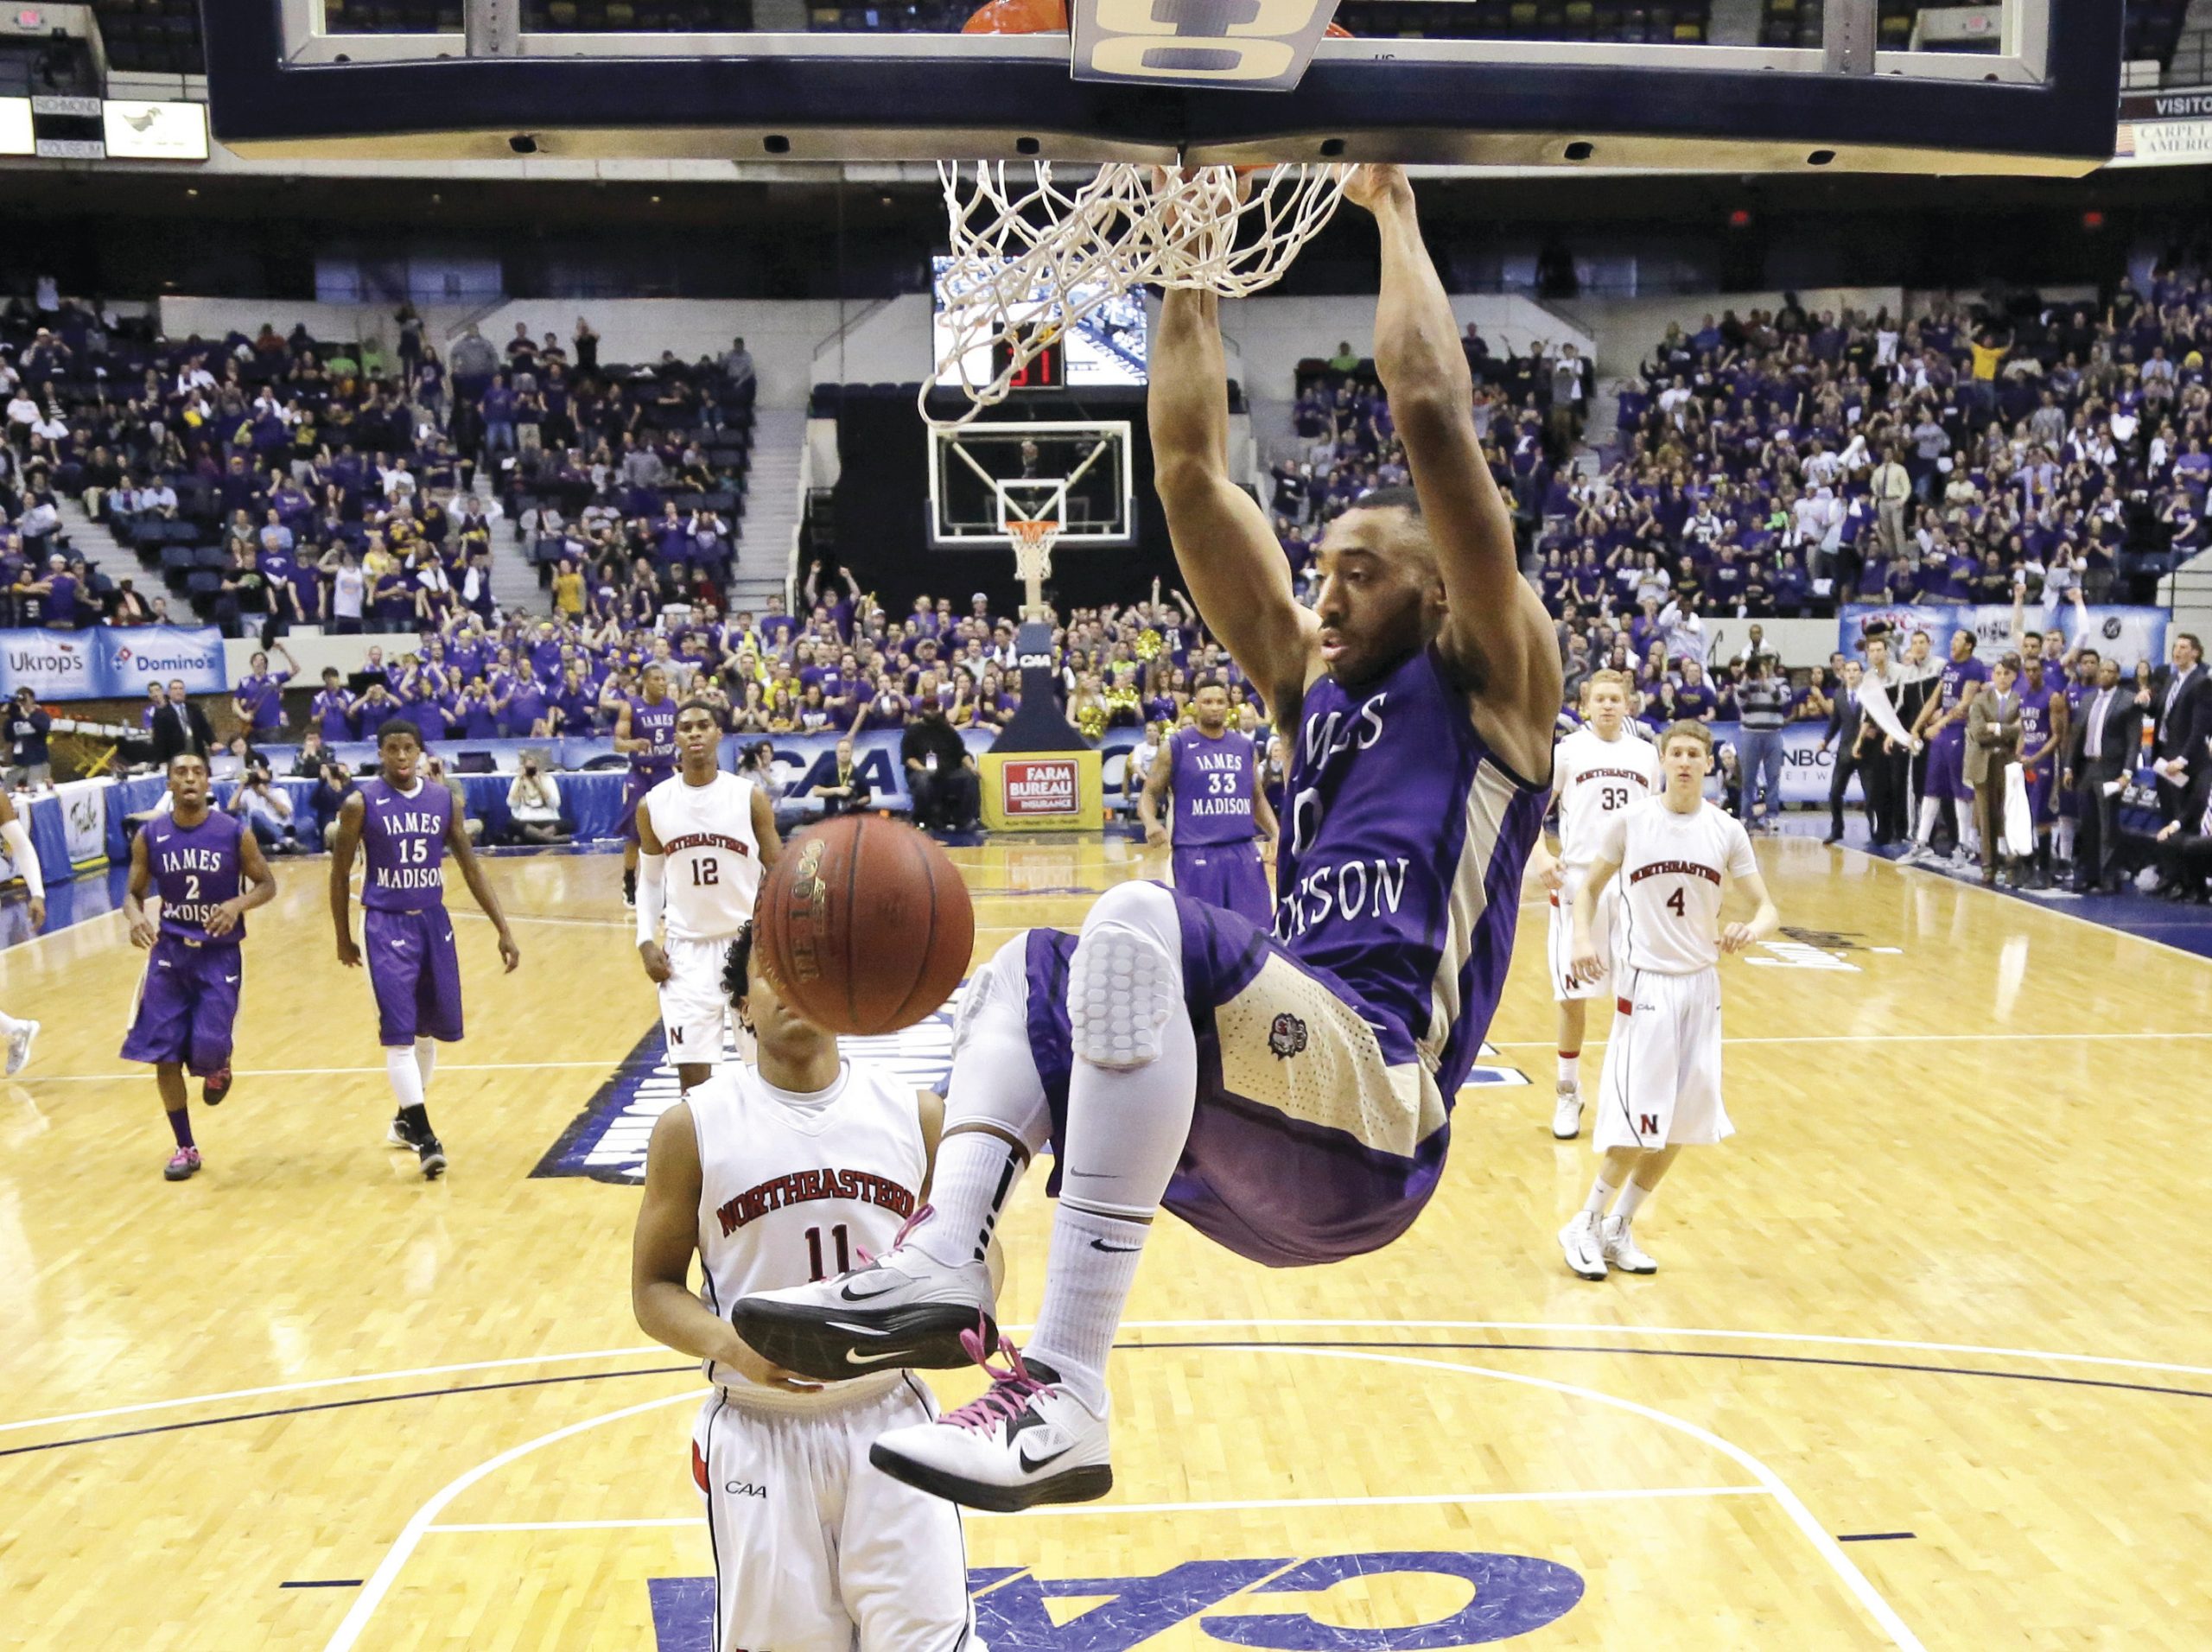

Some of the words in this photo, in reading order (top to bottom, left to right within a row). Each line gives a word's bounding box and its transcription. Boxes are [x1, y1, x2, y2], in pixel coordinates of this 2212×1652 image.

[137, 653, 215, 671] Domino's
[1020, 654, 1051, 667] CAA
[655, 728, 664, 743] 5
[1196, 753, 1242, 771] JAMES
[1027, 766, 1071, 781] FARM
[1208, 773, 1236, 793] 33
[1009, 780, 1072, 796] BUREAU
[1192, 797, 1250, 816] MADISON
[1602, 787, 1628, 810] 33
[378, 812, 442, 836] JAMES
[162, 848, 221, 873] JAMES
[399, 838, 428, 863] 15
[691, 857, 719, 886] 12
[185, 875, 200, 899] 2
[1667, 887, 1685, 917] 4
[1565, 974, 1580, 990] N
[670, 1026, 683, 1046] N
[1640, 1114, 1658, 1134] N
[804, 1223, 850, 1283] 11
[725, 1480, 767, 1499] CAA
